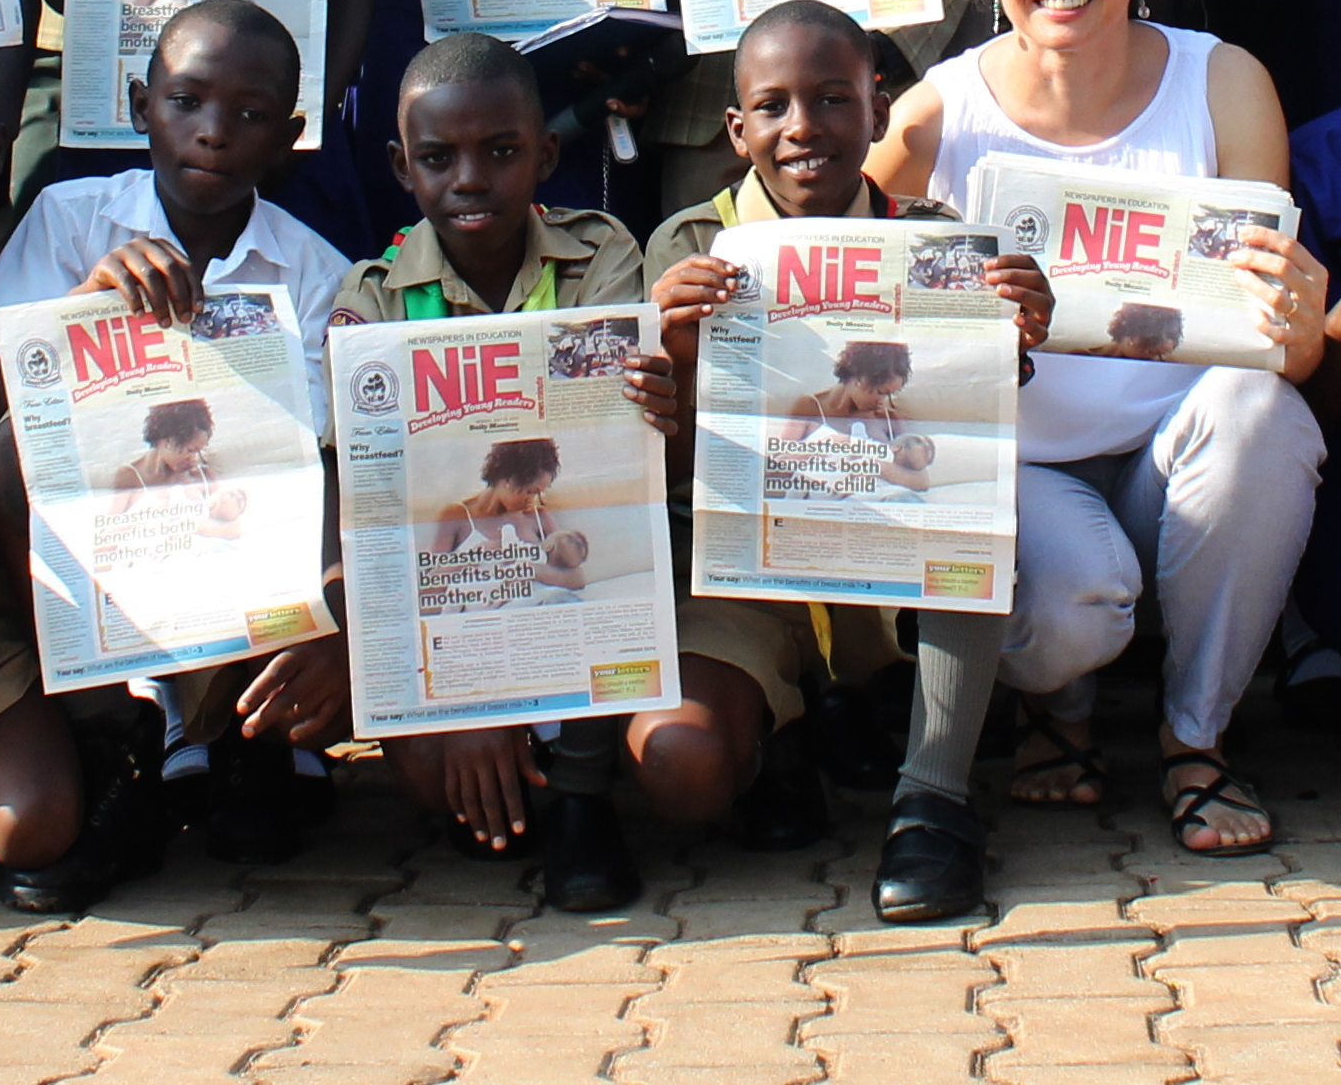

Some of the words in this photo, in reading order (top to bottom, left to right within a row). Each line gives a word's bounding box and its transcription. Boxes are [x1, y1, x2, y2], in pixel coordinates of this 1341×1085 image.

[122, 4, 180, 16] Breastfe
[121, 20, 161, 32] benef
[120, 36, 157, 48] moth
[1064, 191, 1117, 204] NEWSPAPERS
[1128, 199, 1170, 210] EDUCATION
[841, 235, 885, 244] EDUCATION
[1060, 202, 1166, 265] NiE
[777, 245, 882, 305] NiE
[770, 305, 820, 322] Developing
[822, 302, 851, 312] Young
[853, 300, 890, 312] Readers
[408, 334, 464, 346] NEWSPAPERS
[476, 330, 522, 340] EDUCATION
[711, 326, 729, 335] Why
[66, 312, 170, 382] NiE
[710, 335, 761, 344] breastfeed?
[74, 375, 119, 401] Developing
[119, 367, 145, 380] Young
[145, 363, 181, 373] Readers
[412, 342, 522, 412] NiE
[24, 415, 41, 424] Why
[410, 408, 462, 432] Developing
[463, 400, 493, 413] Young
[494, 397, 533, 408] Readers
[349, 443, 370, 454] Why
[349, 449, 405, 462] breastfeed?
[768, 438, 888, 459] Breastfeeding
[767, 456, 837, 471] benefits
[840, 457, 879, 474] both
[766, 477, 831, 493] mother,
[834, 478, 875, 492] child
[94, 503, 203, 528] Breastfeeding
[95, 527, 156, 546] benefits
[160, 519, 195, 536] both
[95, 546, 152, 564] mother,
[156, 536, 192, 554] child
[418, 543, 540, 566] Breastfeeding
[420, 569, 491, 587] benefits
[494, 562, 534, 580] both
[952, 565, 986, 575] letters
[708, 574, 725, 583] Your
[726, 576, 741, 584] say:
[421, 588, 487, 607] mother,
[490, 582, 532, 601] child
[432, 637, 443, 650] E
[593, 668, 616, 678] your
[370, 714, 388, 722] Your
[389, 712, 404, 722] say:
